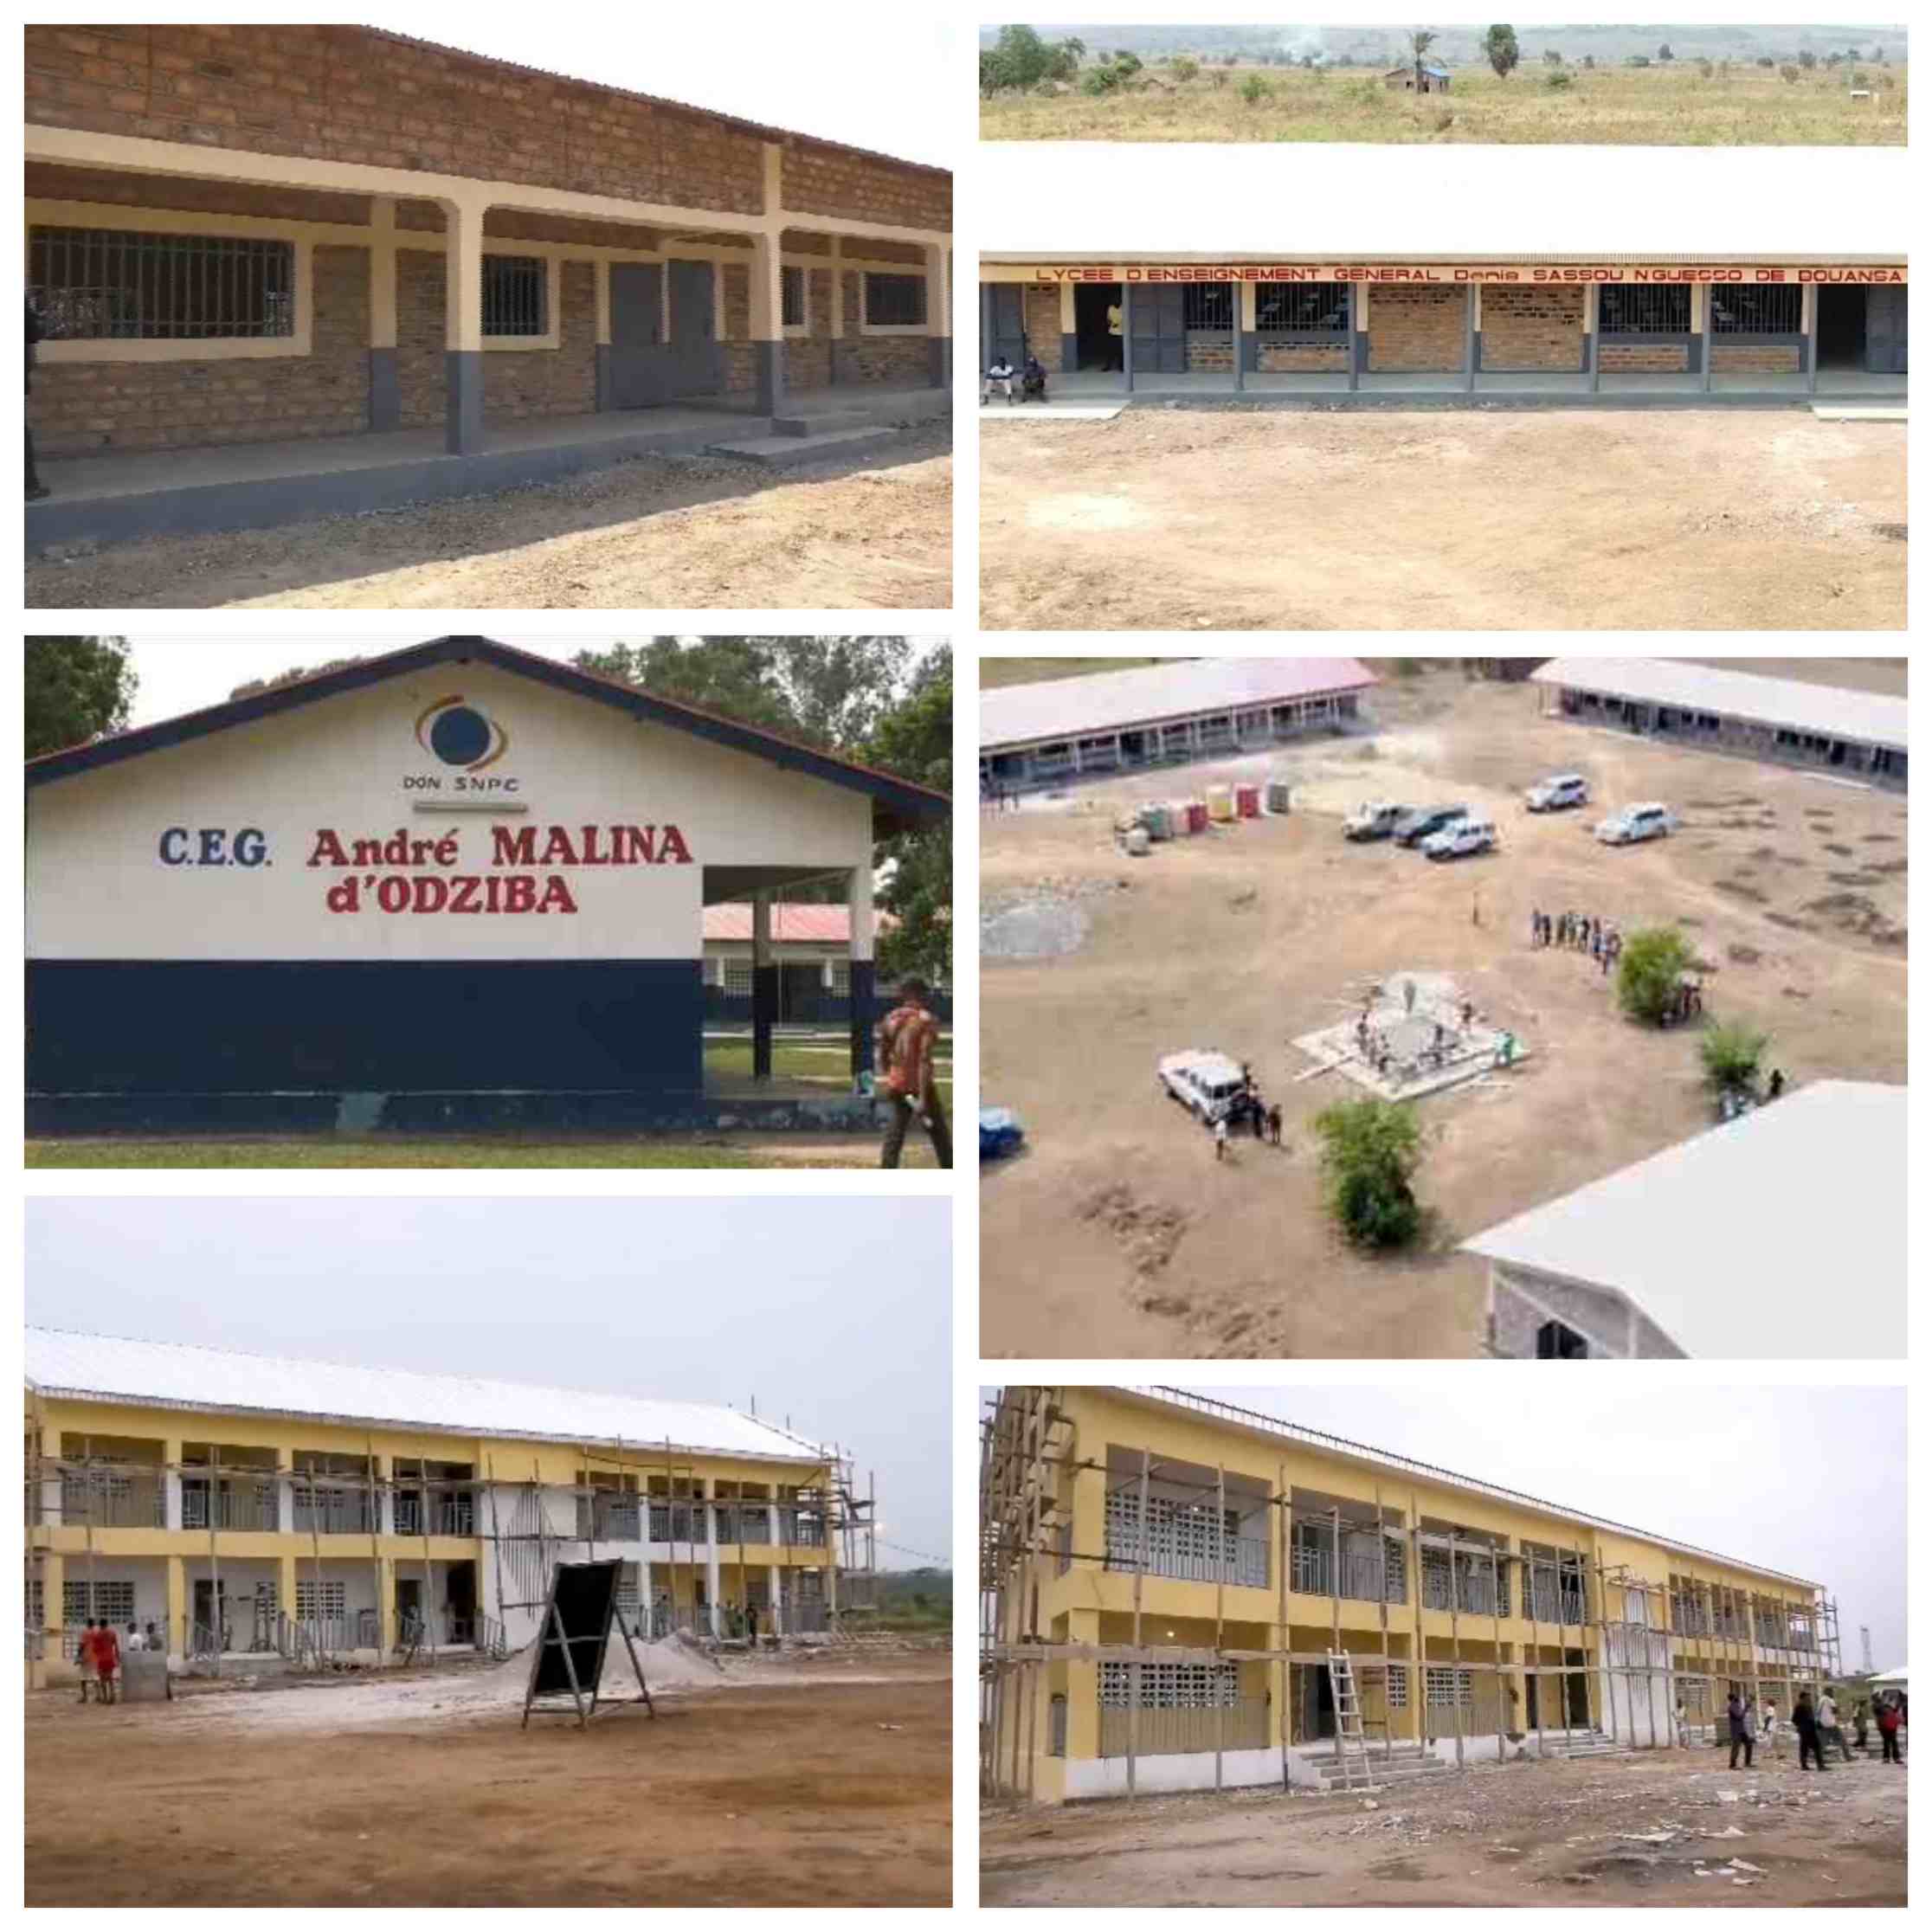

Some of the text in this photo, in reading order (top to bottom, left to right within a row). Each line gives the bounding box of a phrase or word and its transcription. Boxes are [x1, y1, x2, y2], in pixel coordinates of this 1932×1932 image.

[1036, 269, 1113, 280] LYCEE
[1334, 268, 1441, 280] GENERAL
[1533, 269, 1624, 280] SASSOU
[1755, 270, 1785, 281] DE
[402, 776, 519, 792] DON SNPC
[306, 827, 460, 868] André
[491, 825, 694, 866] MALINA
[326, 876, 578, 913] d'ODZIBA
